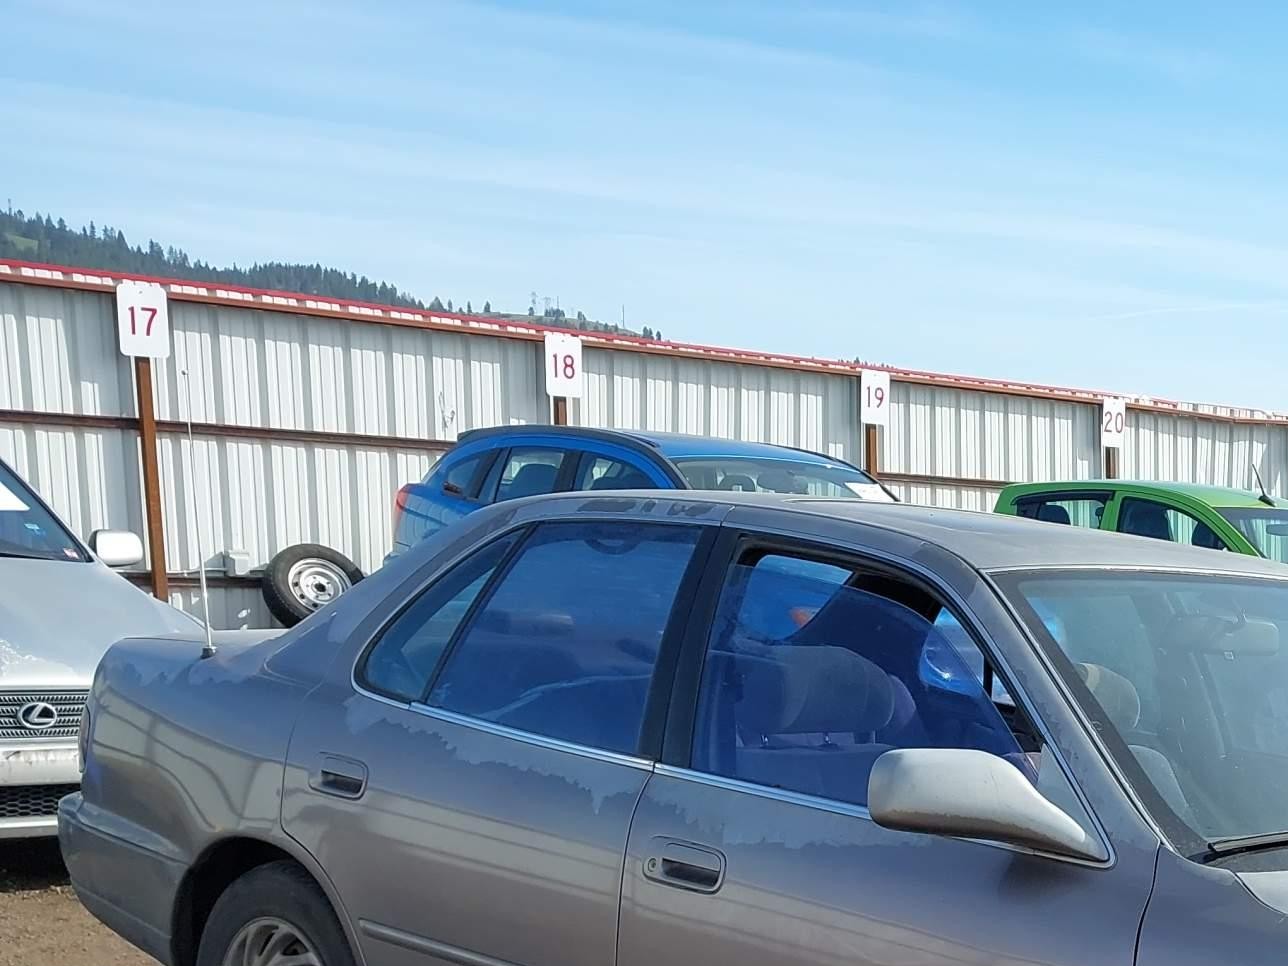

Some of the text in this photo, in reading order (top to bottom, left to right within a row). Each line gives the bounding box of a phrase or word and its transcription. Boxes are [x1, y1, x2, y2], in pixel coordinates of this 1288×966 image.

[127, 306, 158, 337] 17
[551, 353, 576, 380] 18
[865, 386, 884, 408] 19
[1103, 411, 1125, 434] 20
